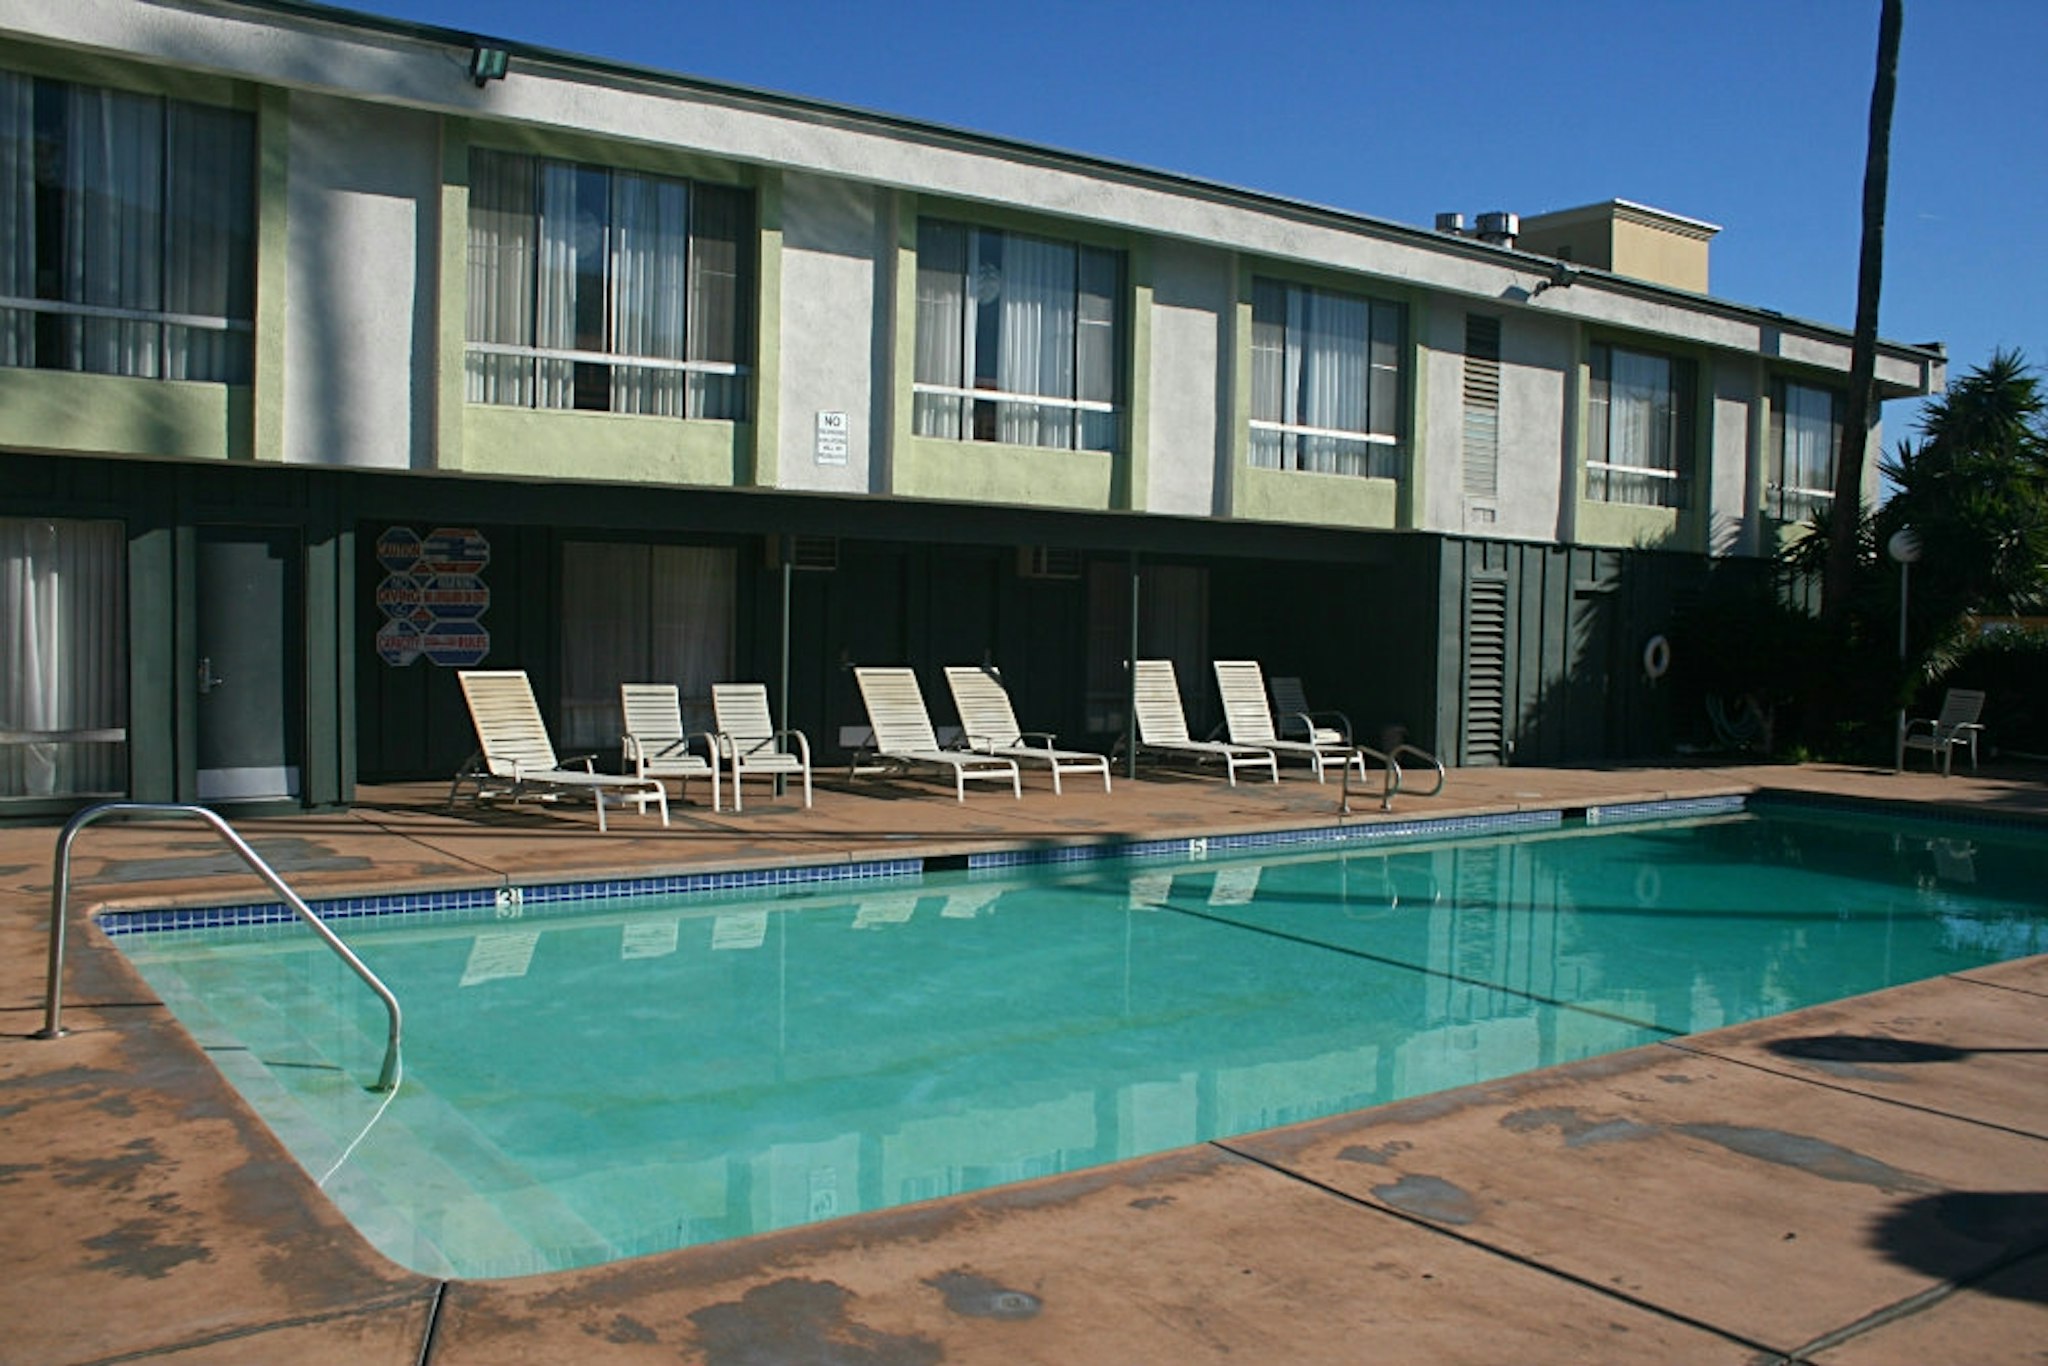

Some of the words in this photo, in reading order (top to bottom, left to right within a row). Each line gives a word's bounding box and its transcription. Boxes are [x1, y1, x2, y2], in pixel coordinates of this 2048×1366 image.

[825, 415, 841, 427] NO
[378, 589, 420, 604] DIVING
[378, 637, 421, 650] CAPACITY
[457, 636, 487, 649] RULES
[1193, 839, 1204, 854] 5
